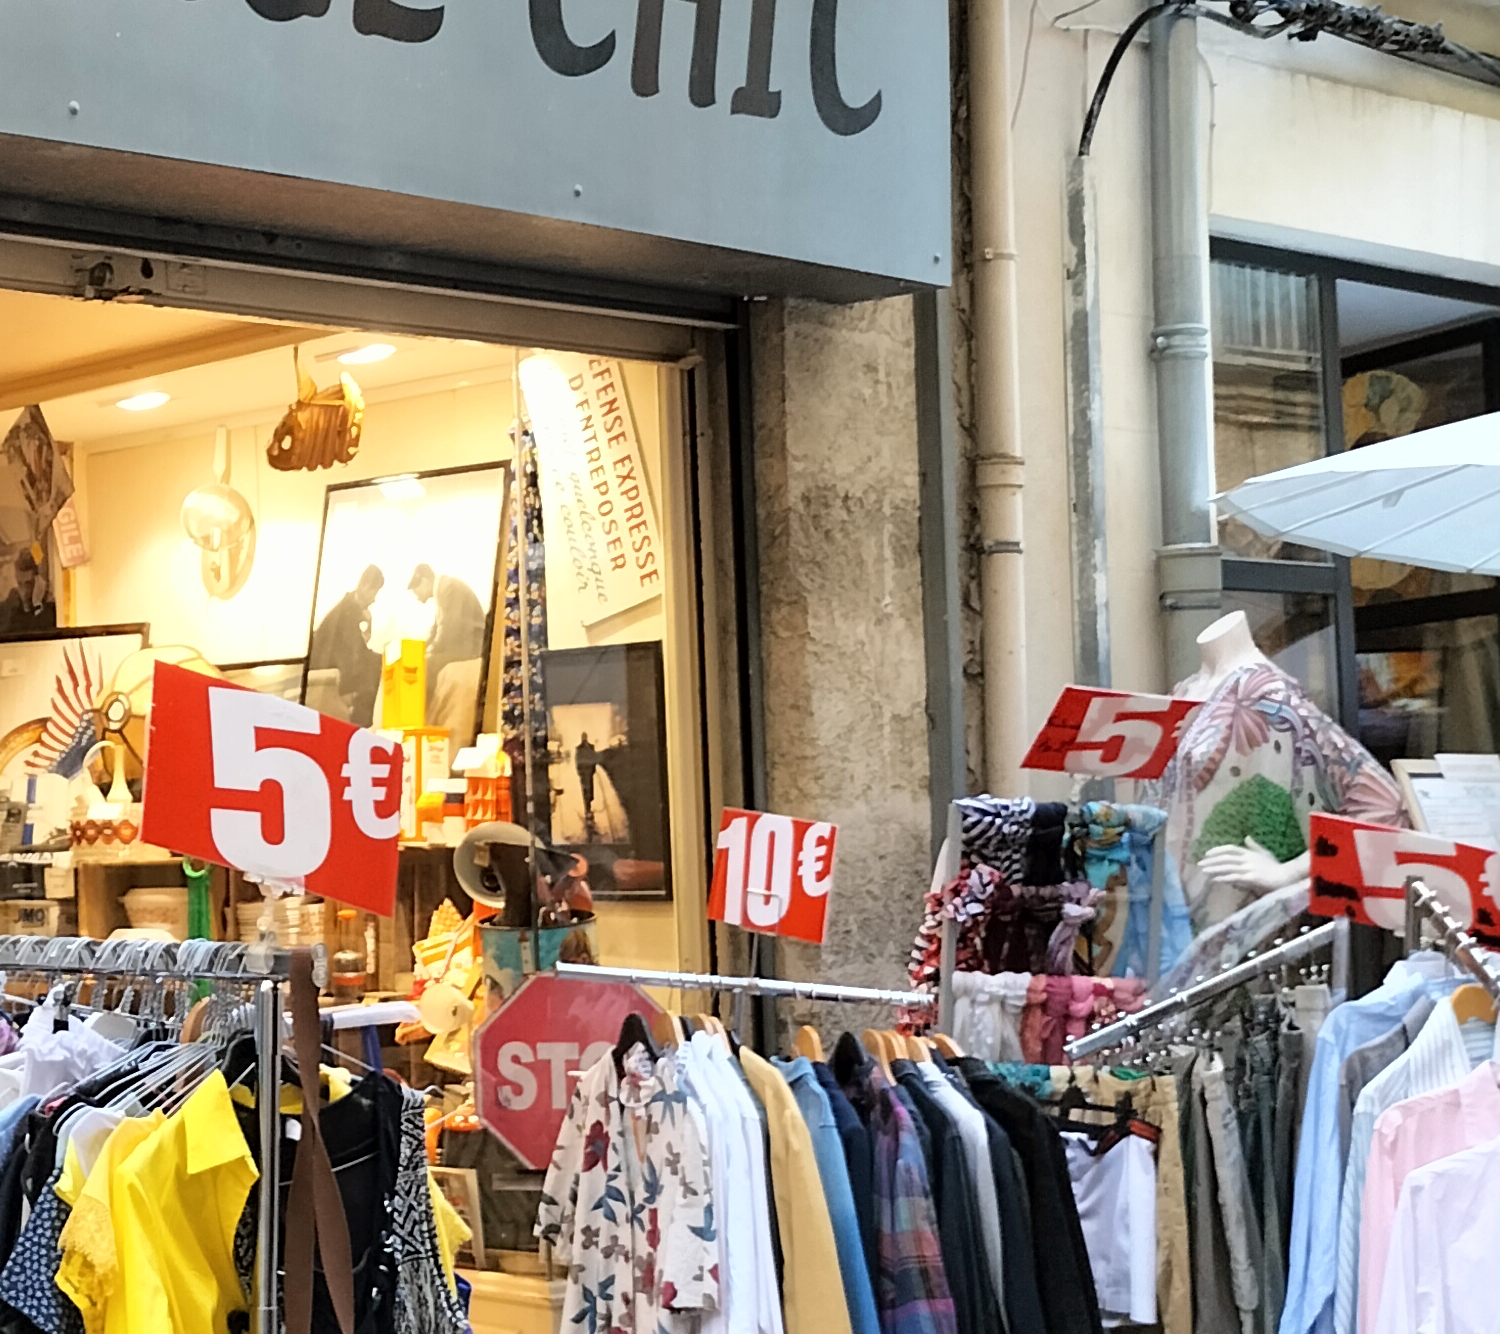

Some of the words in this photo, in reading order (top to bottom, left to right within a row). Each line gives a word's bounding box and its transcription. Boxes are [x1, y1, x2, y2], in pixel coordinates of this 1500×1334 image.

[568, 373, 628, 572] D'ENTREPOSER
[613, 454, 660, 588] EXPRESSE
[716, 813, 832, 927] 10€
